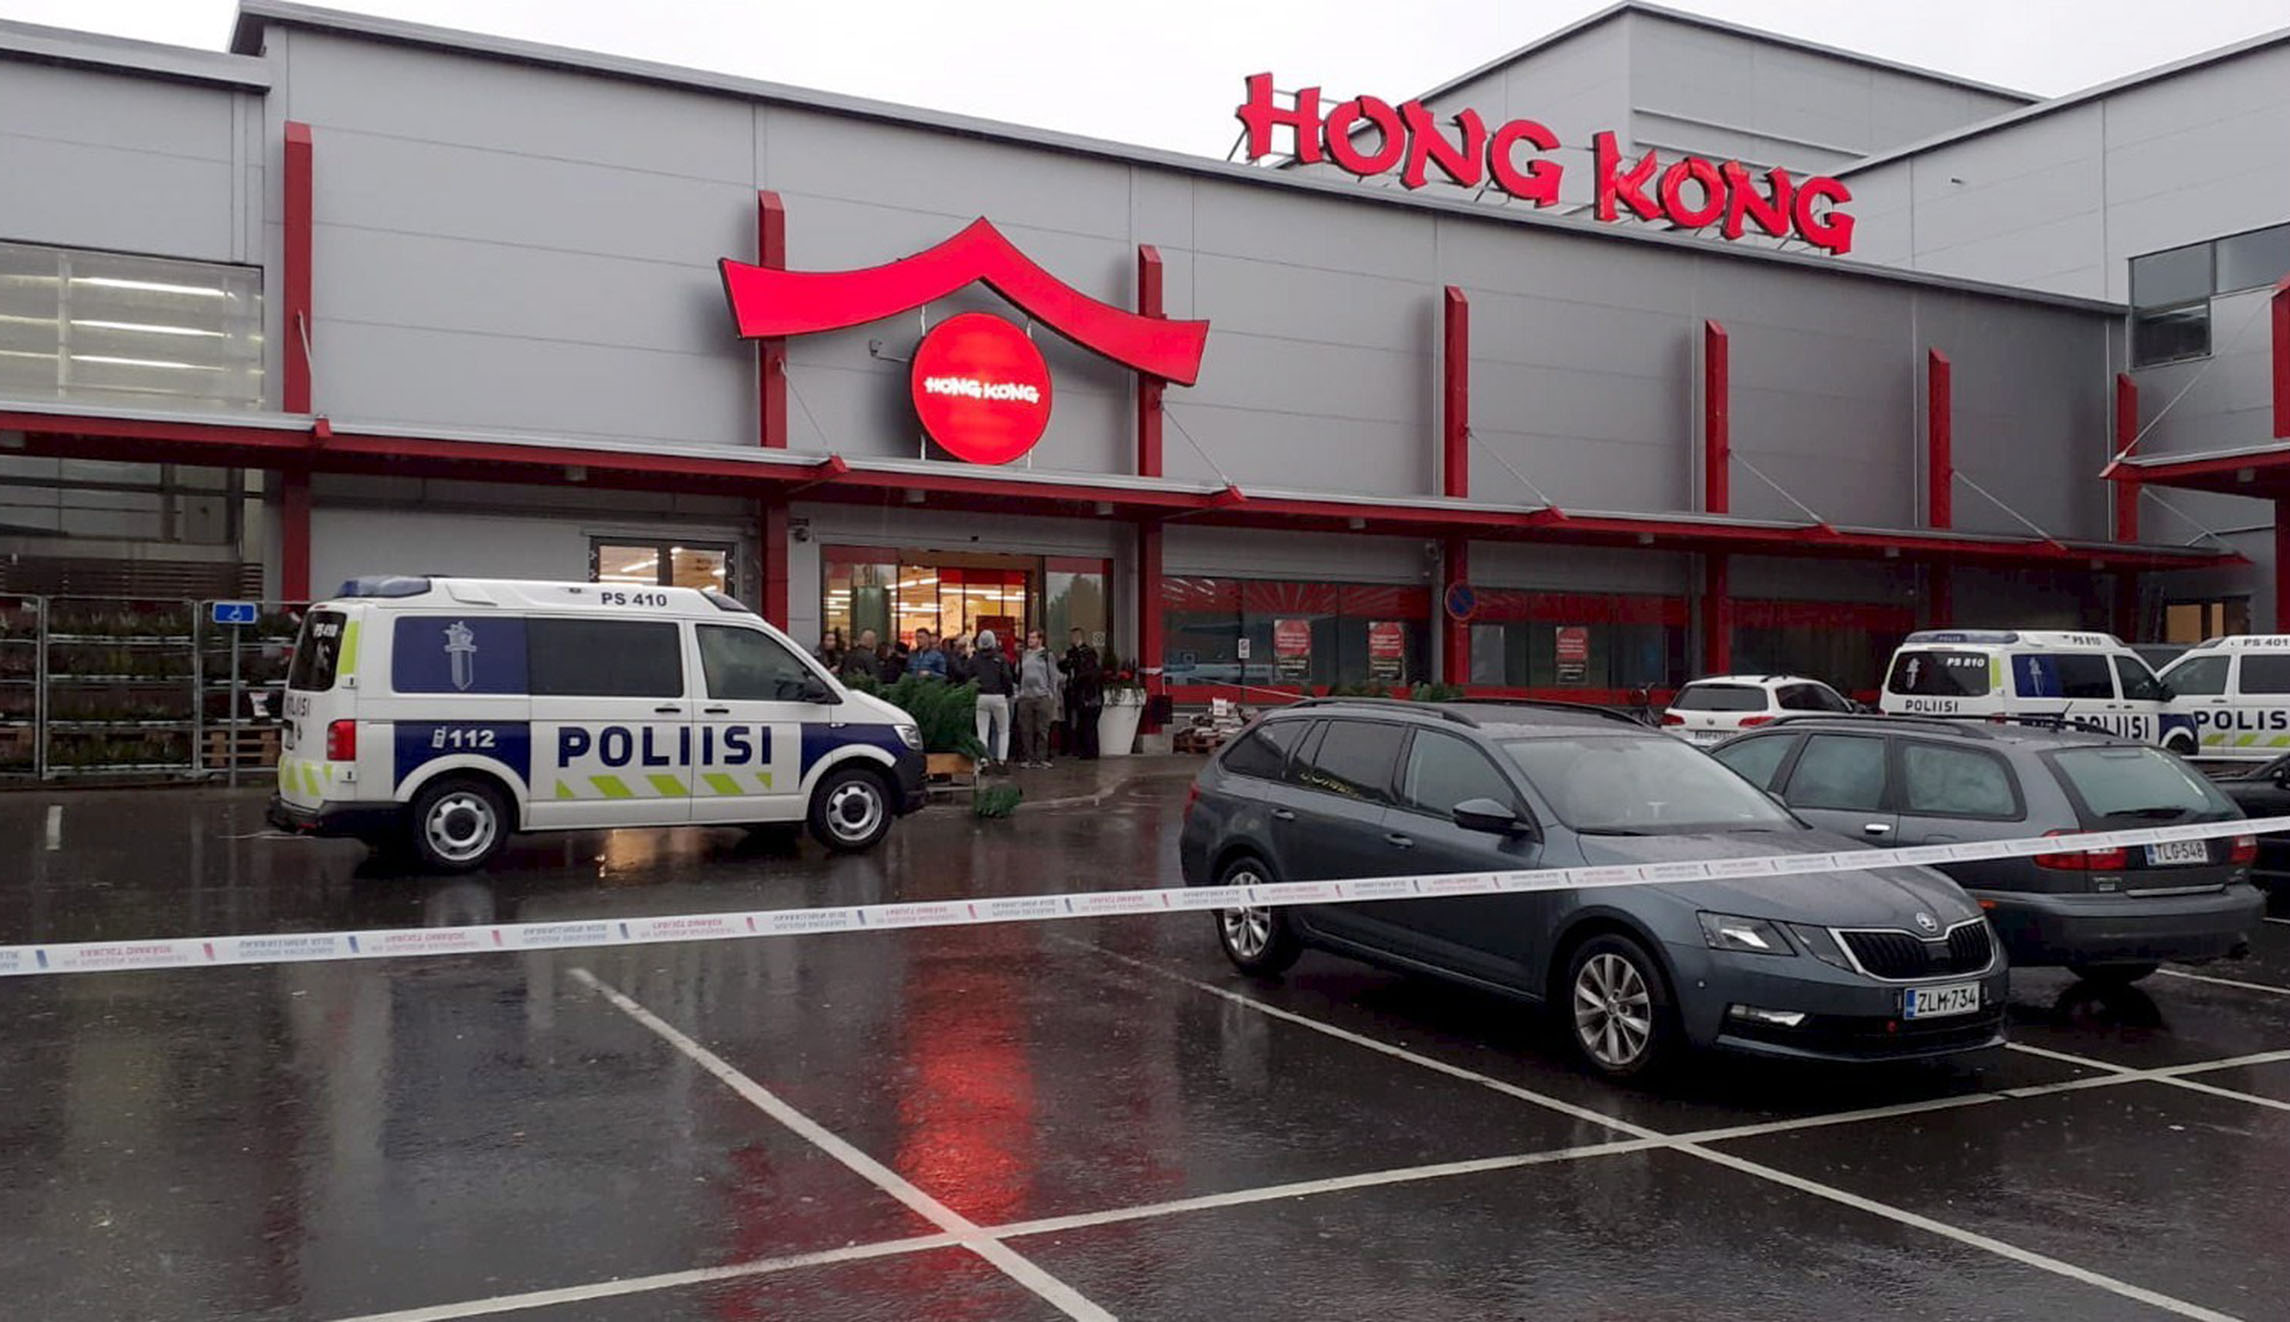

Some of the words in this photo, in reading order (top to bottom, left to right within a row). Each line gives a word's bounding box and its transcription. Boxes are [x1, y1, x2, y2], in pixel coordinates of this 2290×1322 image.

[1236, 72, 1564, 208] HONG
[1593, 131, 1855, 256] KONG
[924, 376, 982, 399] HONG
[983, 382, 1040, 404] KONG
[601, 591, 627, 606] PS
[632, 593, 668, 607] 410
[2242, 638, 2261, 647] PS
[2264, 638, 2289, 647] 401
[1946, 657, 1962, 667] PS
[1904, 699, 1959, 713] POLIISI
[2193, 710, 2288, 731] POLIS
[449, 729, 496, 748] 112
[557, 725, 773, 768] POLIISI
[1917, 988, 1977, 1013] ZLM-734
